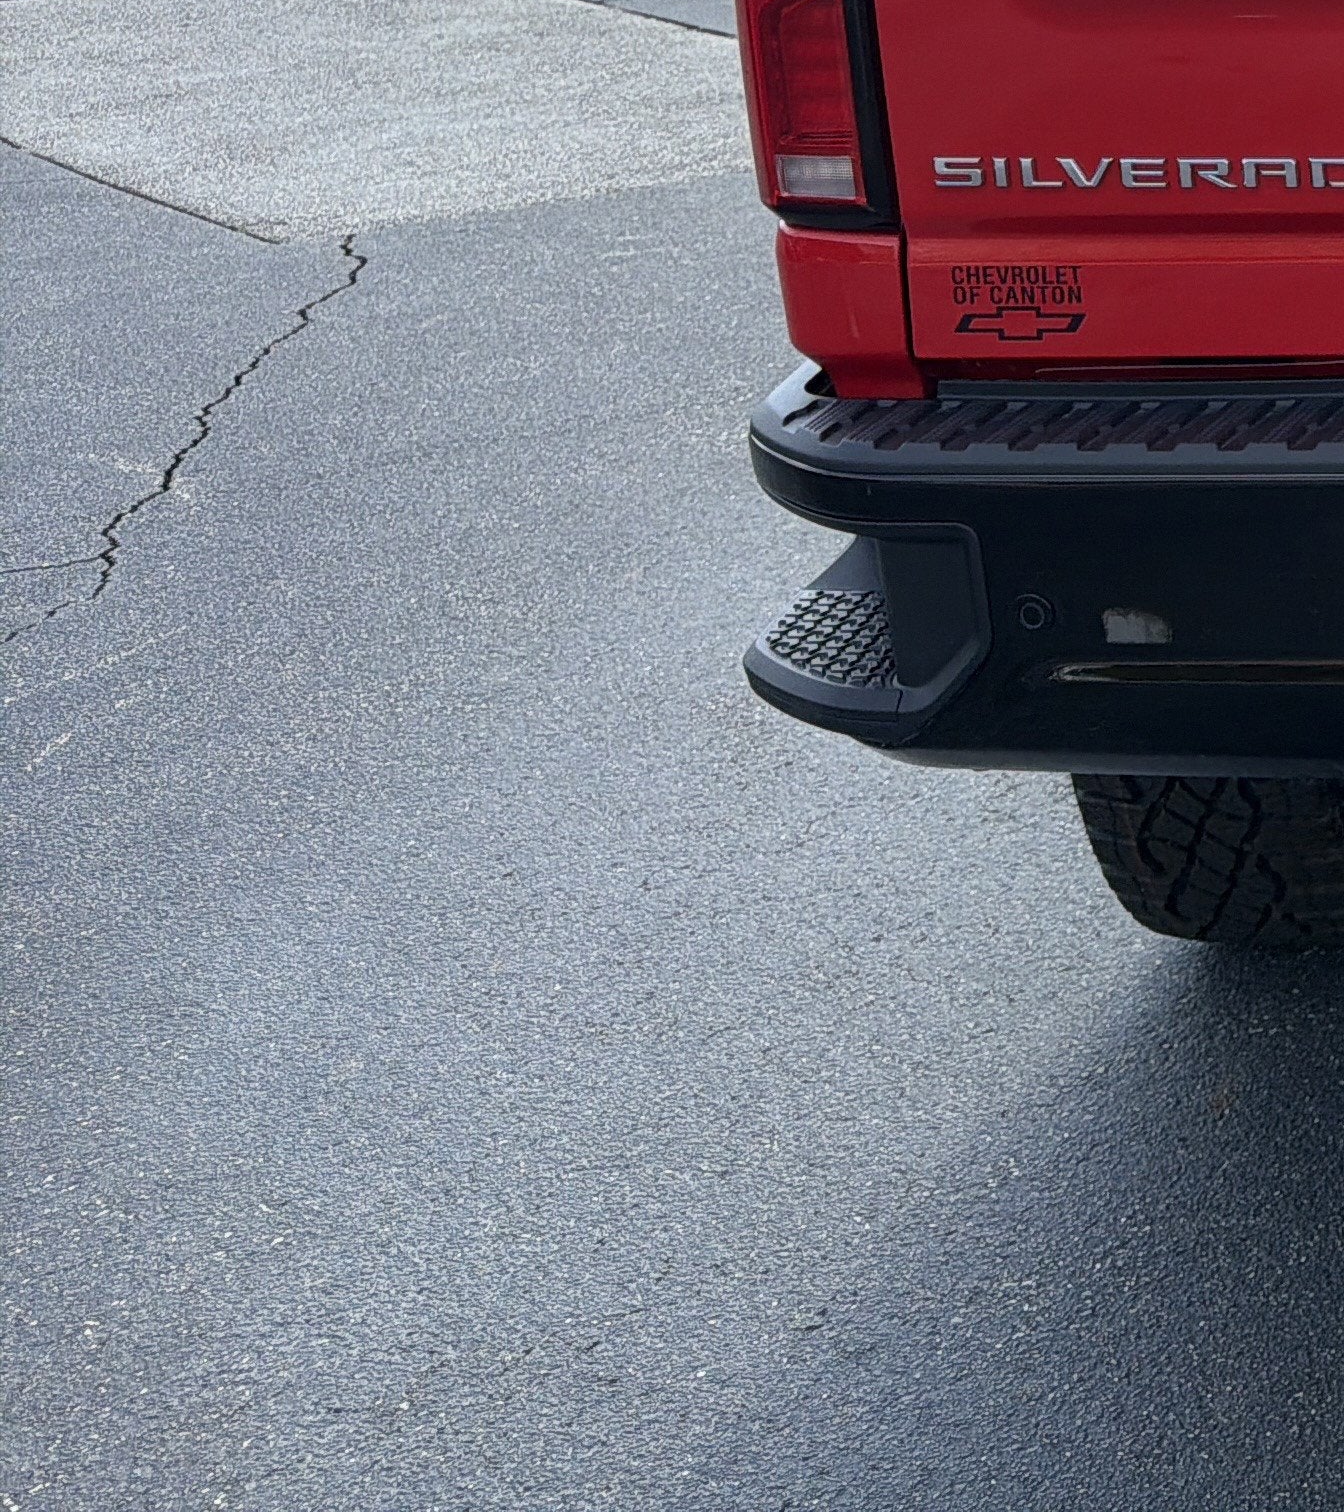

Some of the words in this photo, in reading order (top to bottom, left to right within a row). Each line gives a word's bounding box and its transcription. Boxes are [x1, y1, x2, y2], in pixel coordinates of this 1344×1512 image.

[951, 265, 1082, 285] CHEVROLET
[953, 286, 981, 305] OF
[990, 286, 1082, 305] CANTON
